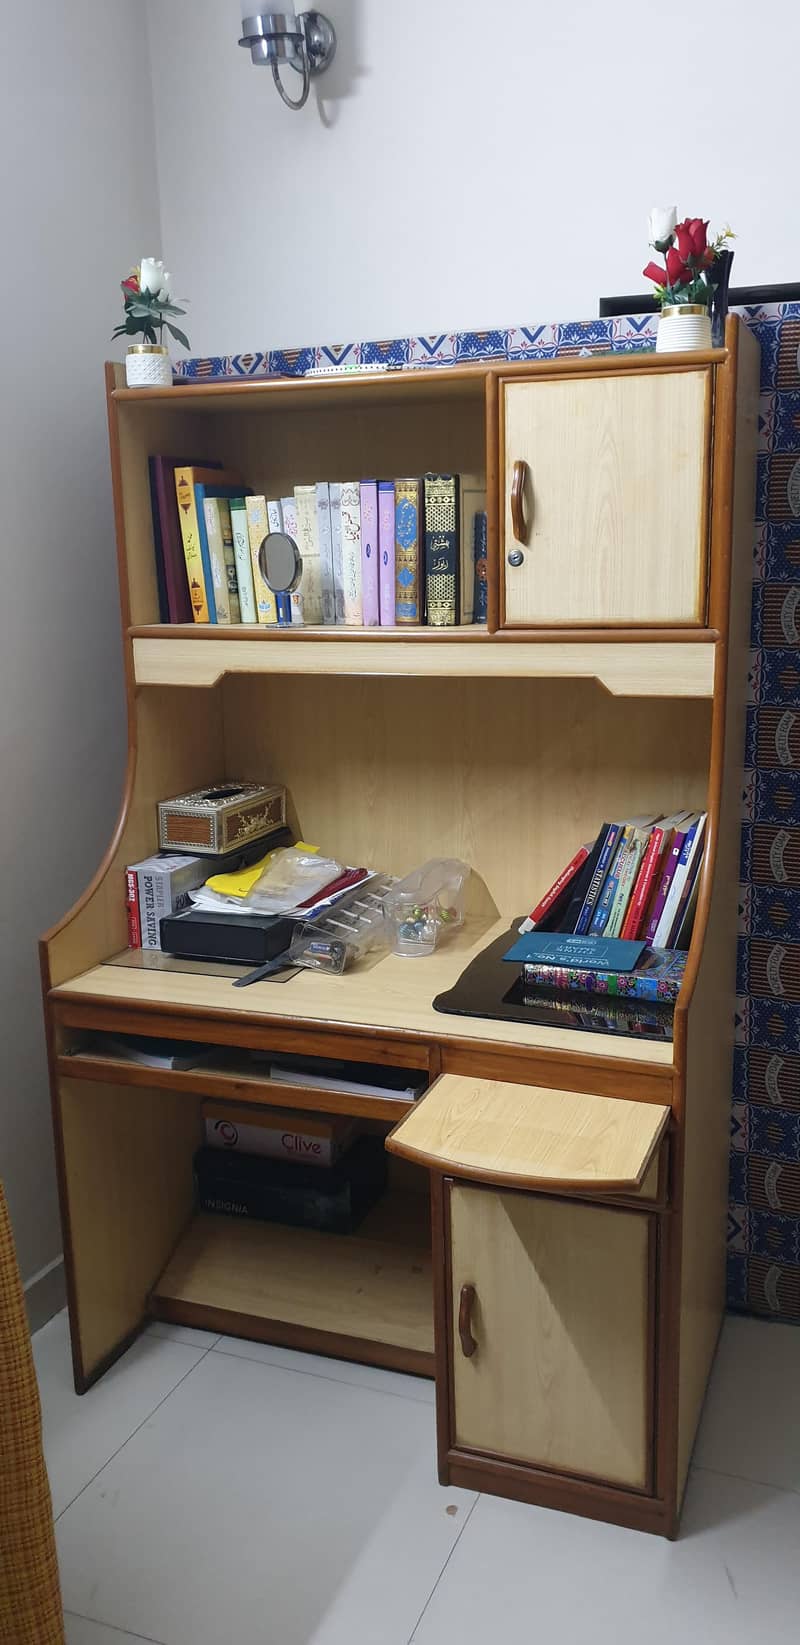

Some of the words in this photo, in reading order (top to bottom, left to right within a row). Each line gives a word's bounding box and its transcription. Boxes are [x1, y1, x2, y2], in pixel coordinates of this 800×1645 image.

[144, 875, 154, 912] POWER
[586, 869, 604, 906] STATISTICS
[146, 911, 157, 946] SAVING
[559, 956, 609, 967] World's
[281, 1134, 321, 1154] Clive
[205, 1200, 248, 1214] INSIGNIA
